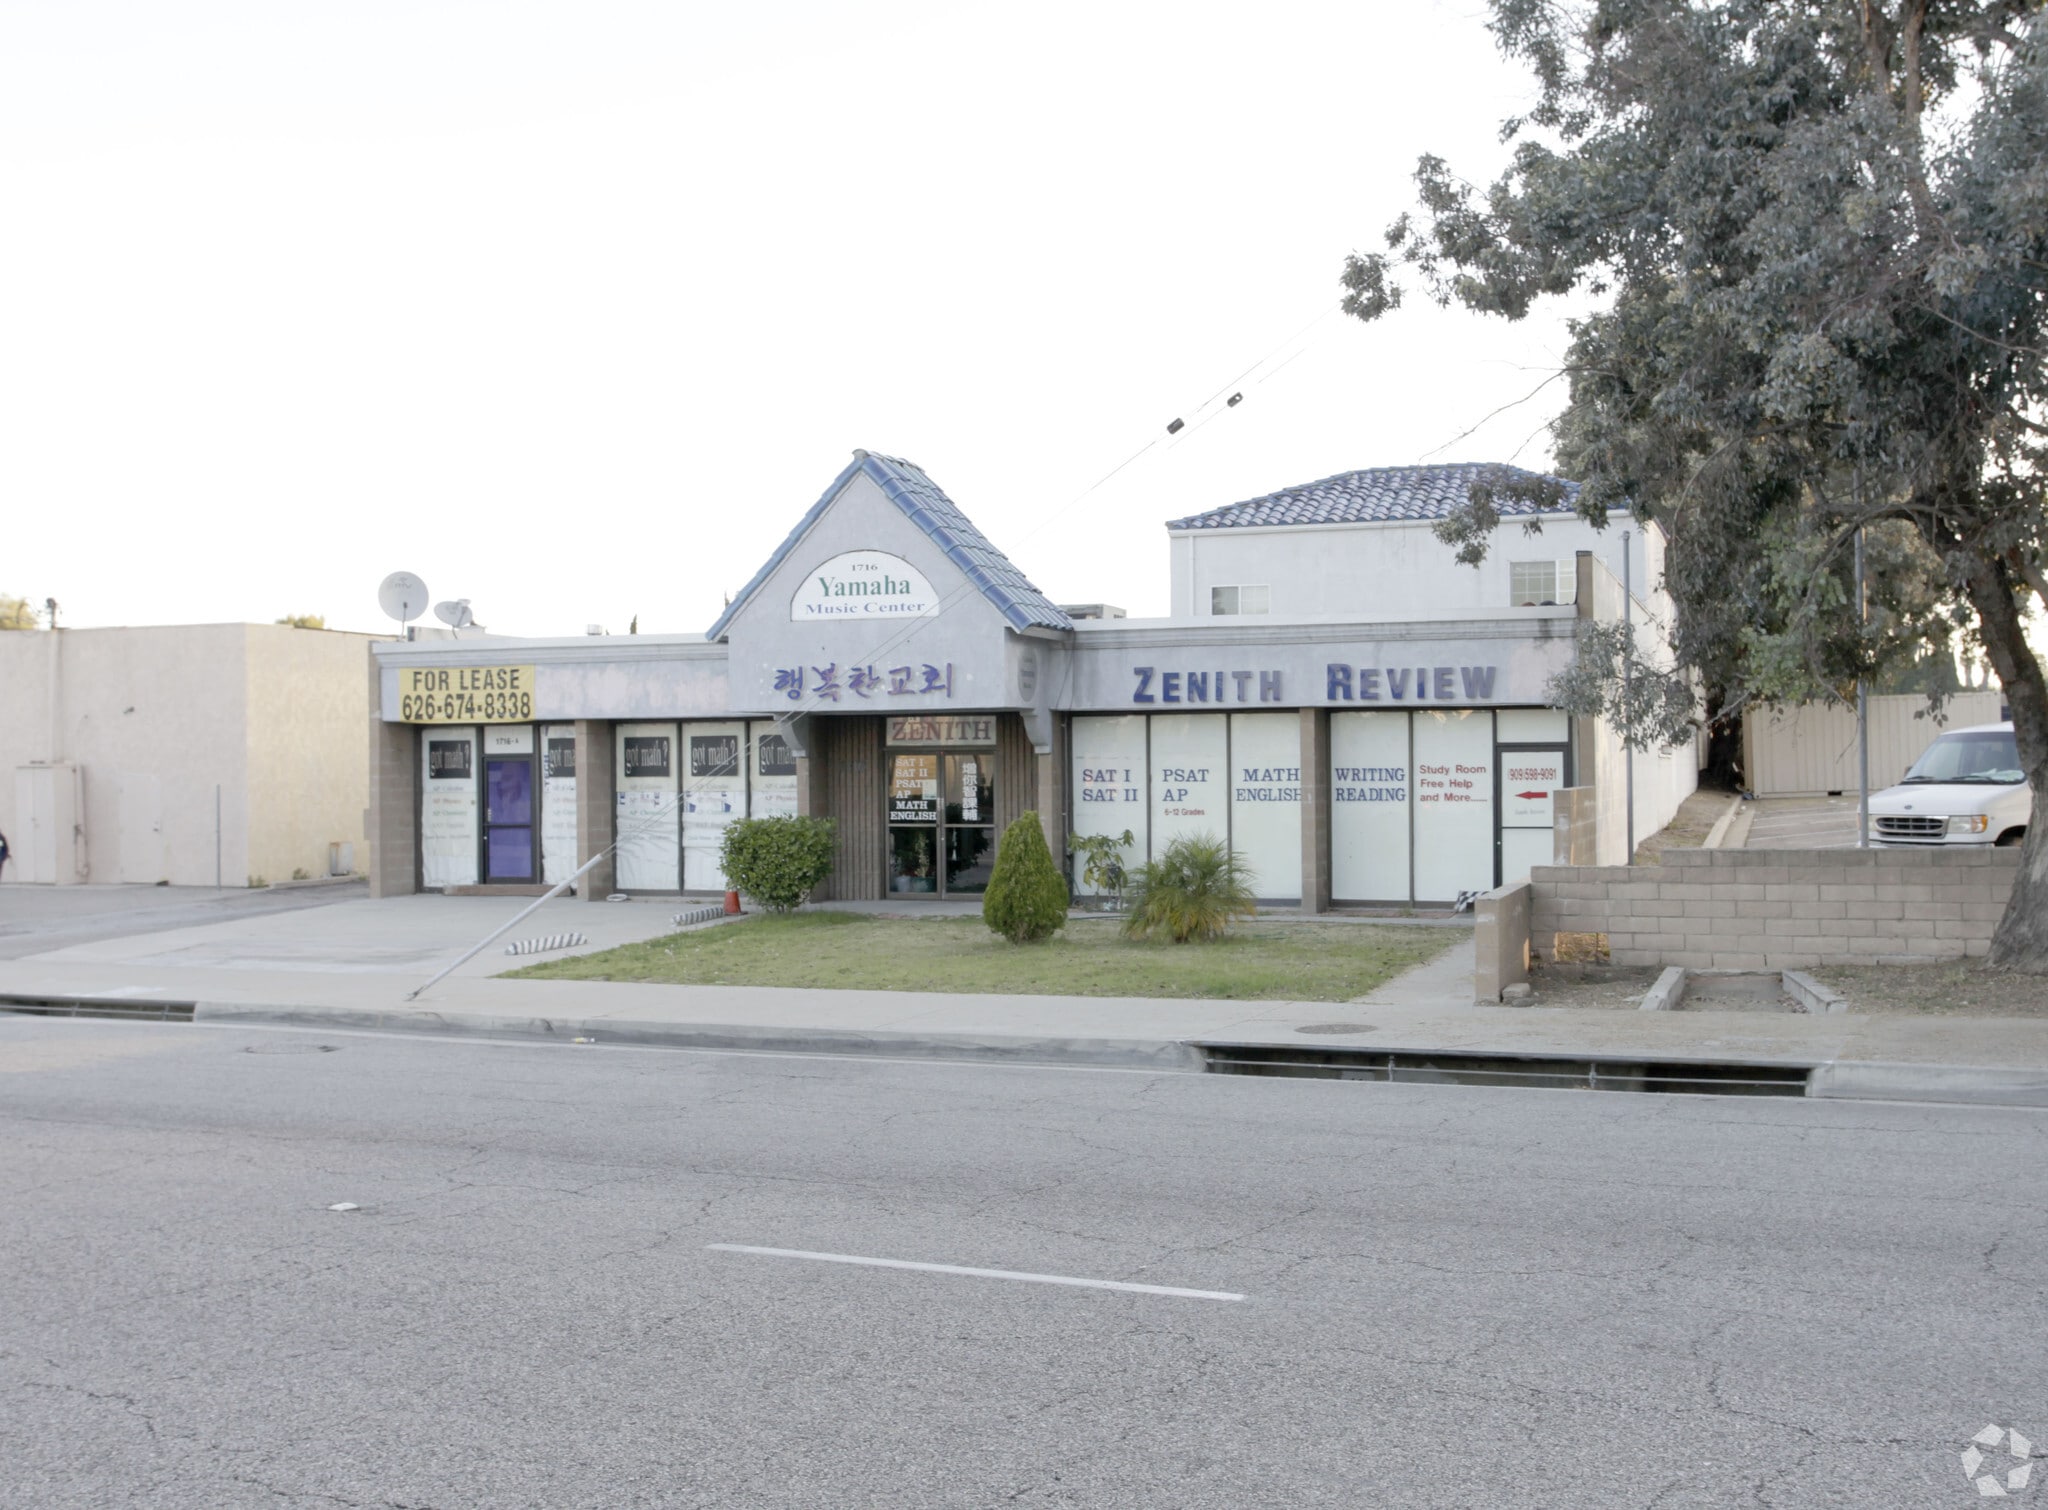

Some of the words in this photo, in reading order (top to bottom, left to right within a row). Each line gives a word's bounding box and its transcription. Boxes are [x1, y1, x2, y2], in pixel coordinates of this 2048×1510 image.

[818, 575, 911, 597] Yamaha
[806, 603, 858, 614] Music
[863, 602, 925, 613] Center
[413, 671, 450, 691] FOR
[460, 669, 520, 690] LEASE
[1133, 666, 1282, 703] ZENITH
[1327, 663, 1497, 700] REVIEW
[402, 692, 531, 720] 626-674-8338
[892, 721, 992, 740] ZENITH
[895, 758, 915, 767] SAT
[895, 769, 915, 777] SAT
[1082, 769, 1117, 782] SAT
[1123, 769, 1131, 782] I
[1162, 769, 1209, 782] PSAT
[1243, 768, 1300, 782] MATH
[1335, 768, 1405, 781] WRITING
[1419, 764, 1450, 775] Study
[1455, 764, 1487, 773] Room
[1420, 779, 1444, 788] Free
[1449, 779, 1473, 789] Help
[896, 790, 911, 799] AP
[1082, 789, 1117, 802] SAT
[1124, 789, 1139, 802] II
[1162, 789, 1188, 802] AP
[1236, 788, 1301, 802] ENGLISH
[1335, 788, 1406, 801] READING
[1420, 793, 1439, 801] and
[896, 801, 928, 810] MATH
[890, 812, 937, 820] ENGLISH
